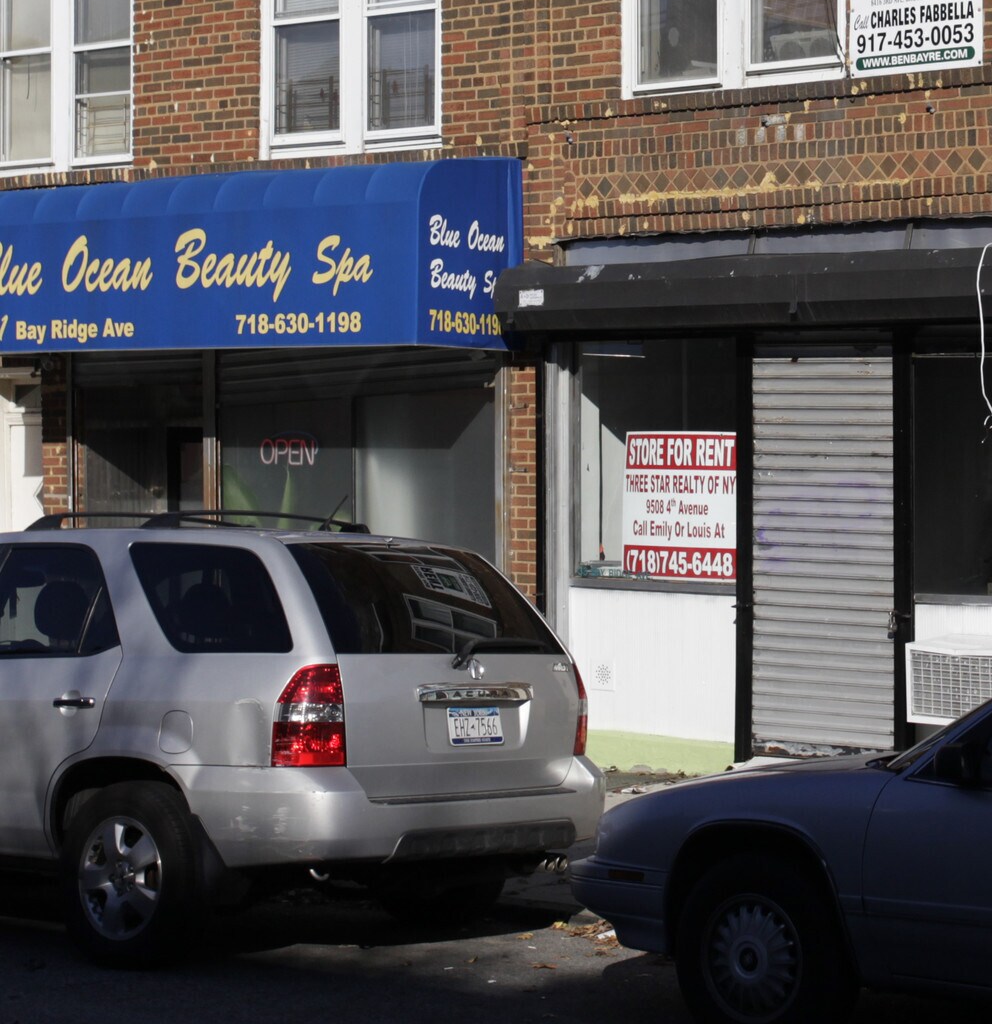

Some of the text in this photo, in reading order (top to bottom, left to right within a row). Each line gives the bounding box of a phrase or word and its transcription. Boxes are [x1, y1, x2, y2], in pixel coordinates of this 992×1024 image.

[854, 1, 974, 31] Call CHARLES FABBELLA
[857, 23, 974, 54] 917-453-0053
[862, 48, 968, 69] WWW.BENBAYRE.COM
[429, 214, 505, 253] Blue Ocean
[0, 227, 374, 303] lue Ocean Beauty Spa
[429, 258, 477, 301] Beauty
[15, 320, 47, 345] Bay
[51, 318, 98, 344] Ridge
[102, 317, 135, 338] Ave
[235, 311, 362, 335] 718-630-1198
[429, 309, 502, 336] 718-630-119
[259, 438, 316, 466] OPEN
[628, 438, 735, 467] STORE FOR RENT
[626, 474, 736, 495] THREE STAR REALTY OF NY
[646, 498, 709, 516] 9508 4th Avenue
[633, 520, 725, 541] Call Emily Or Louis At
[626, 549, 734, 576] (718)745-6448
[452, 690, 509, 698] ACURA
